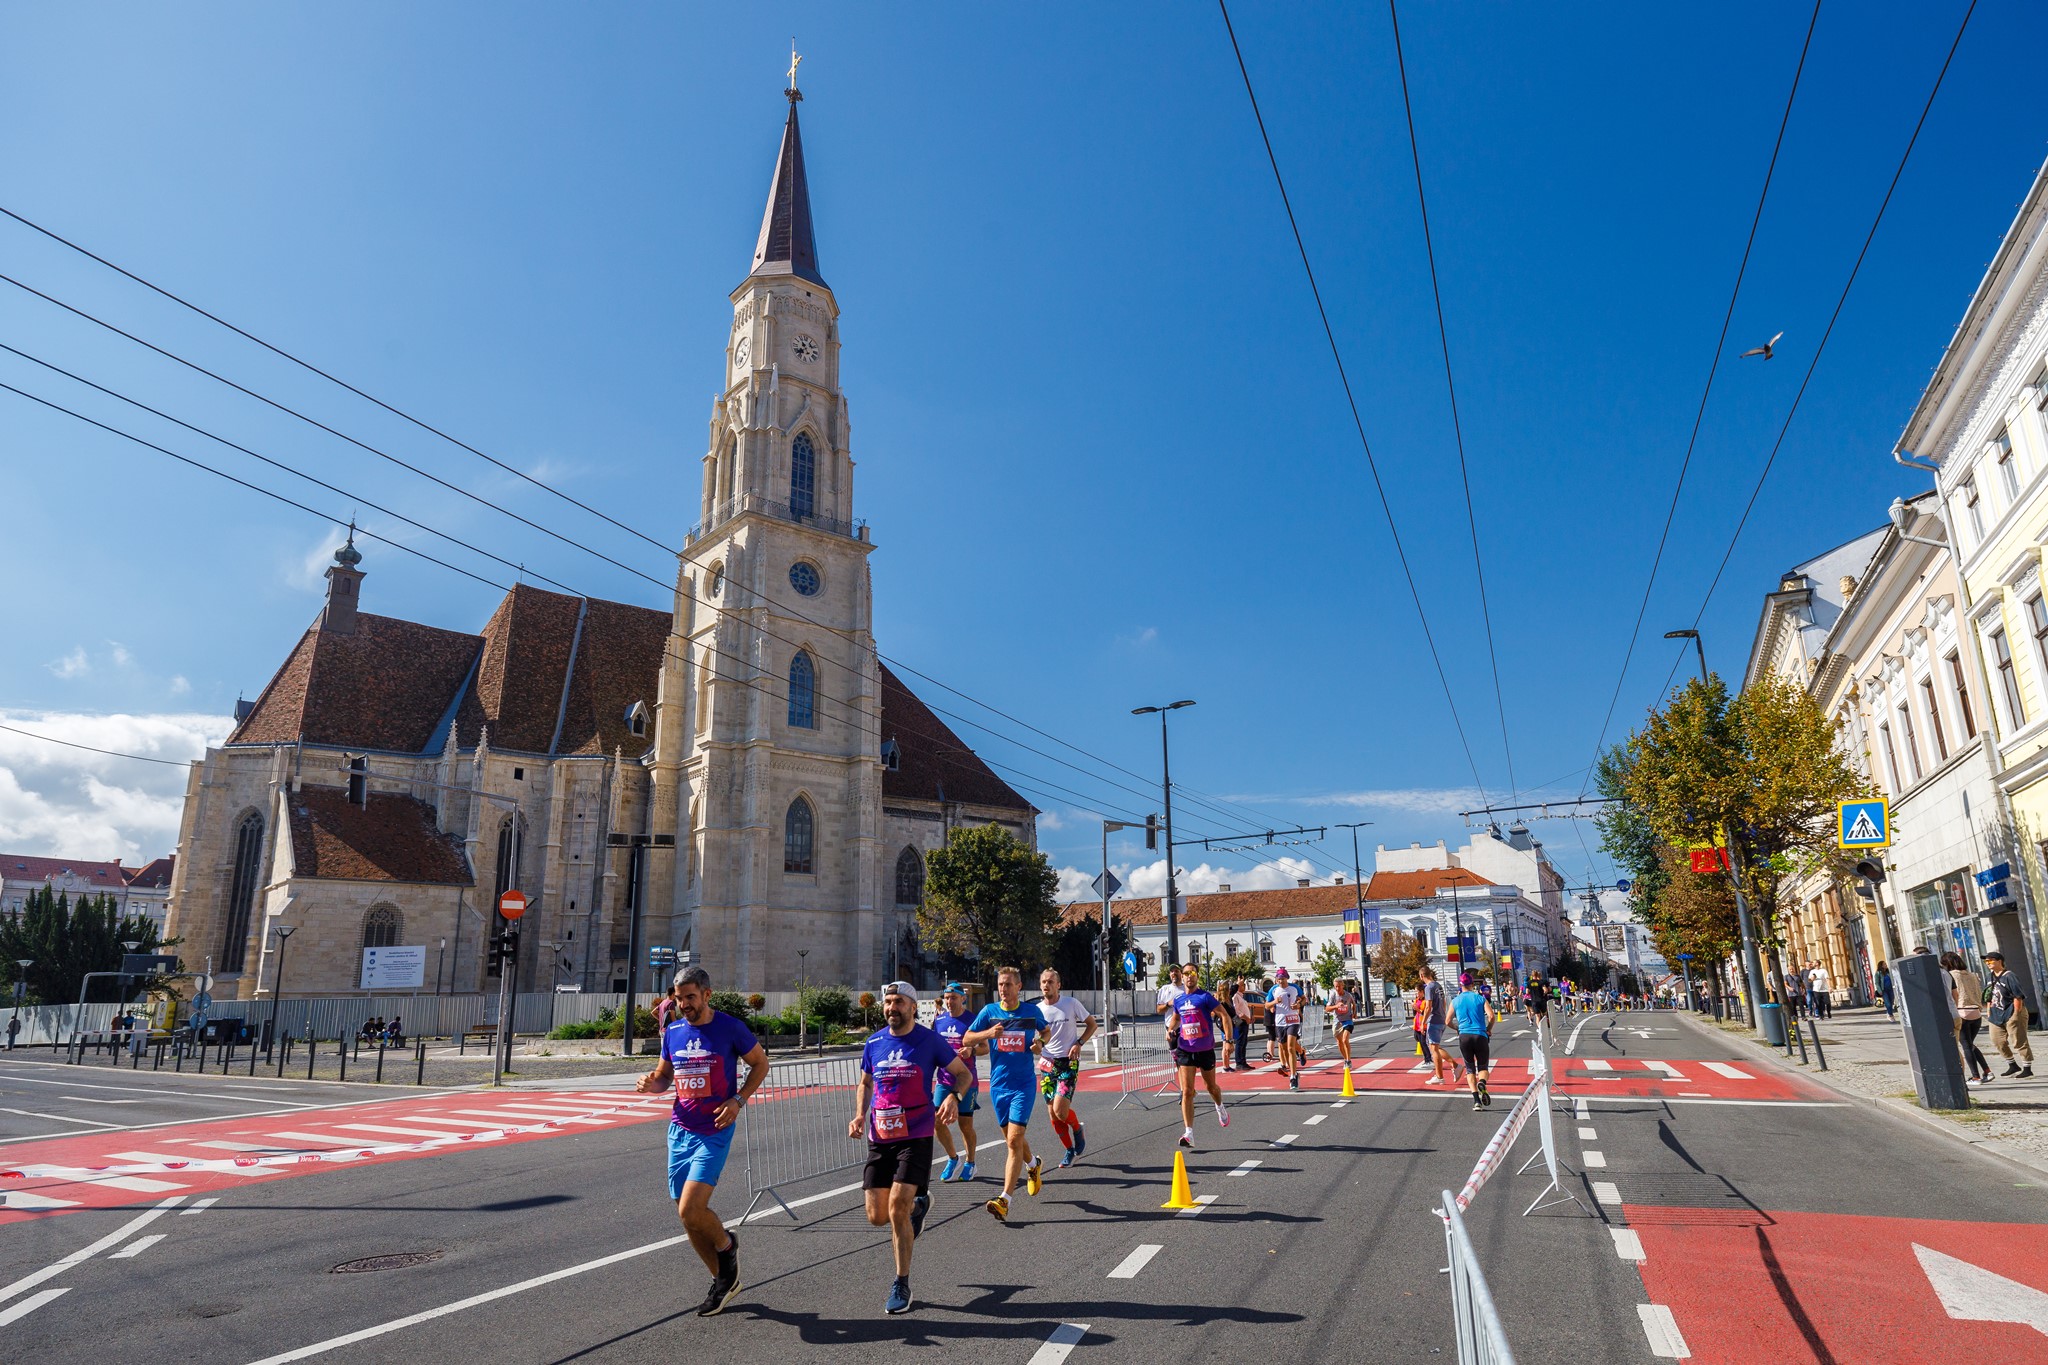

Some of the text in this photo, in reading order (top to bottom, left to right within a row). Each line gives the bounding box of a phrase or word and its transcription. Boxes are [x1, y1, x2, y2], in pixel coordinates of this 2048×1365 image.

[1000, 1037, 1023, 1046] 1344
[677, 1077, 706, 1089] 1769
[876, 1118, 903, 1131] 1454
